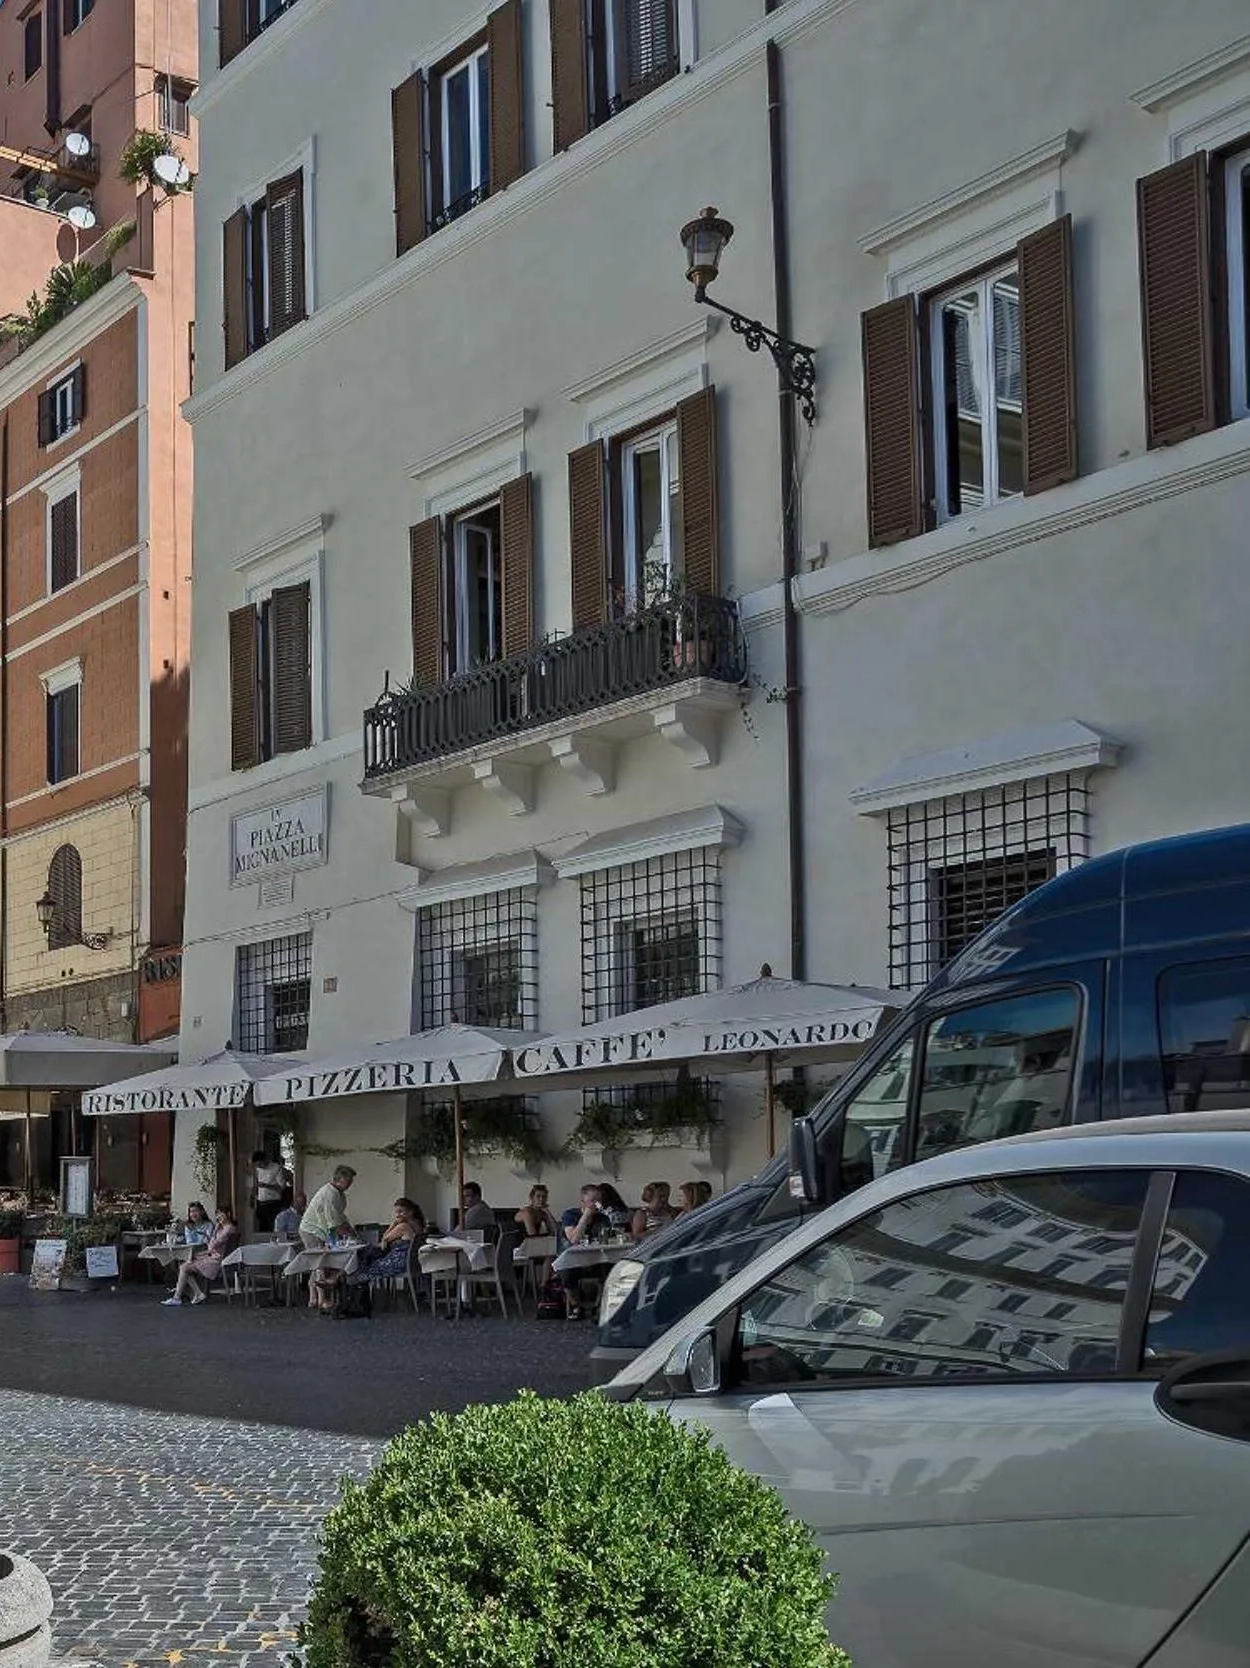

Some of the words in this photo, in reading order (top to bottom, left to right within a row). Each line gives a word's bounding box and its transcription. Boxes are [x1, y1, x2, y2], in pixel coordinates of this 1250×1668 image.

[251, 818, 305, 848] PIAZZA
[271, 809, 281, 821] IN
[236, 832, 322, 873] MIGNANELLI
[516, 1029, 667, 1074] CAFFE'
[703, 1020, 873, 1052] LEONARDO
[286, 1058, 461, 1100] PIZZERIA
[88, 1082, 245, 1113] RISTORANTE
